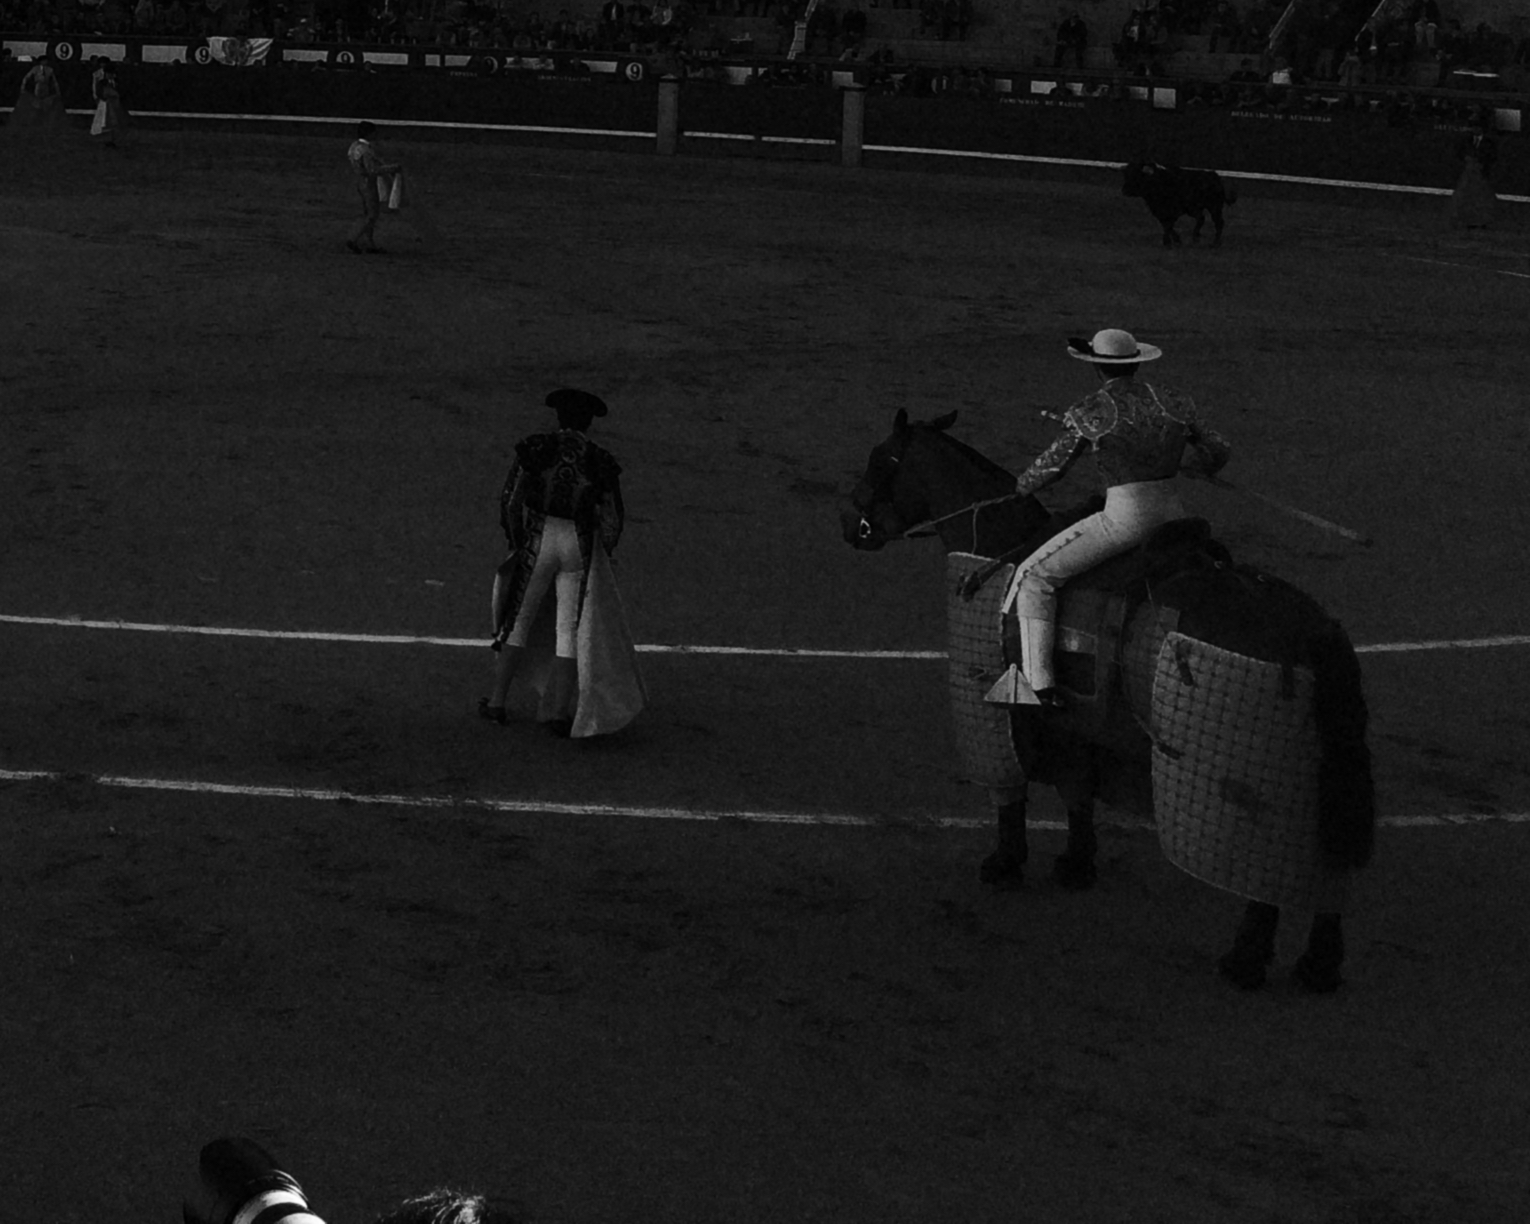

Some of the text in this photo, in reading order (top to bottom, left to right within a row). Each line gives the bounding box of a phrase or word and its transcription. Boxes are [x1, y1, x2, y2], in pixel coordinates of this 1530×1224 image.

[59, 43, 69, 59] 9
[199, 47, 208, 62] 9
[630, 63, 641, 79] 9
